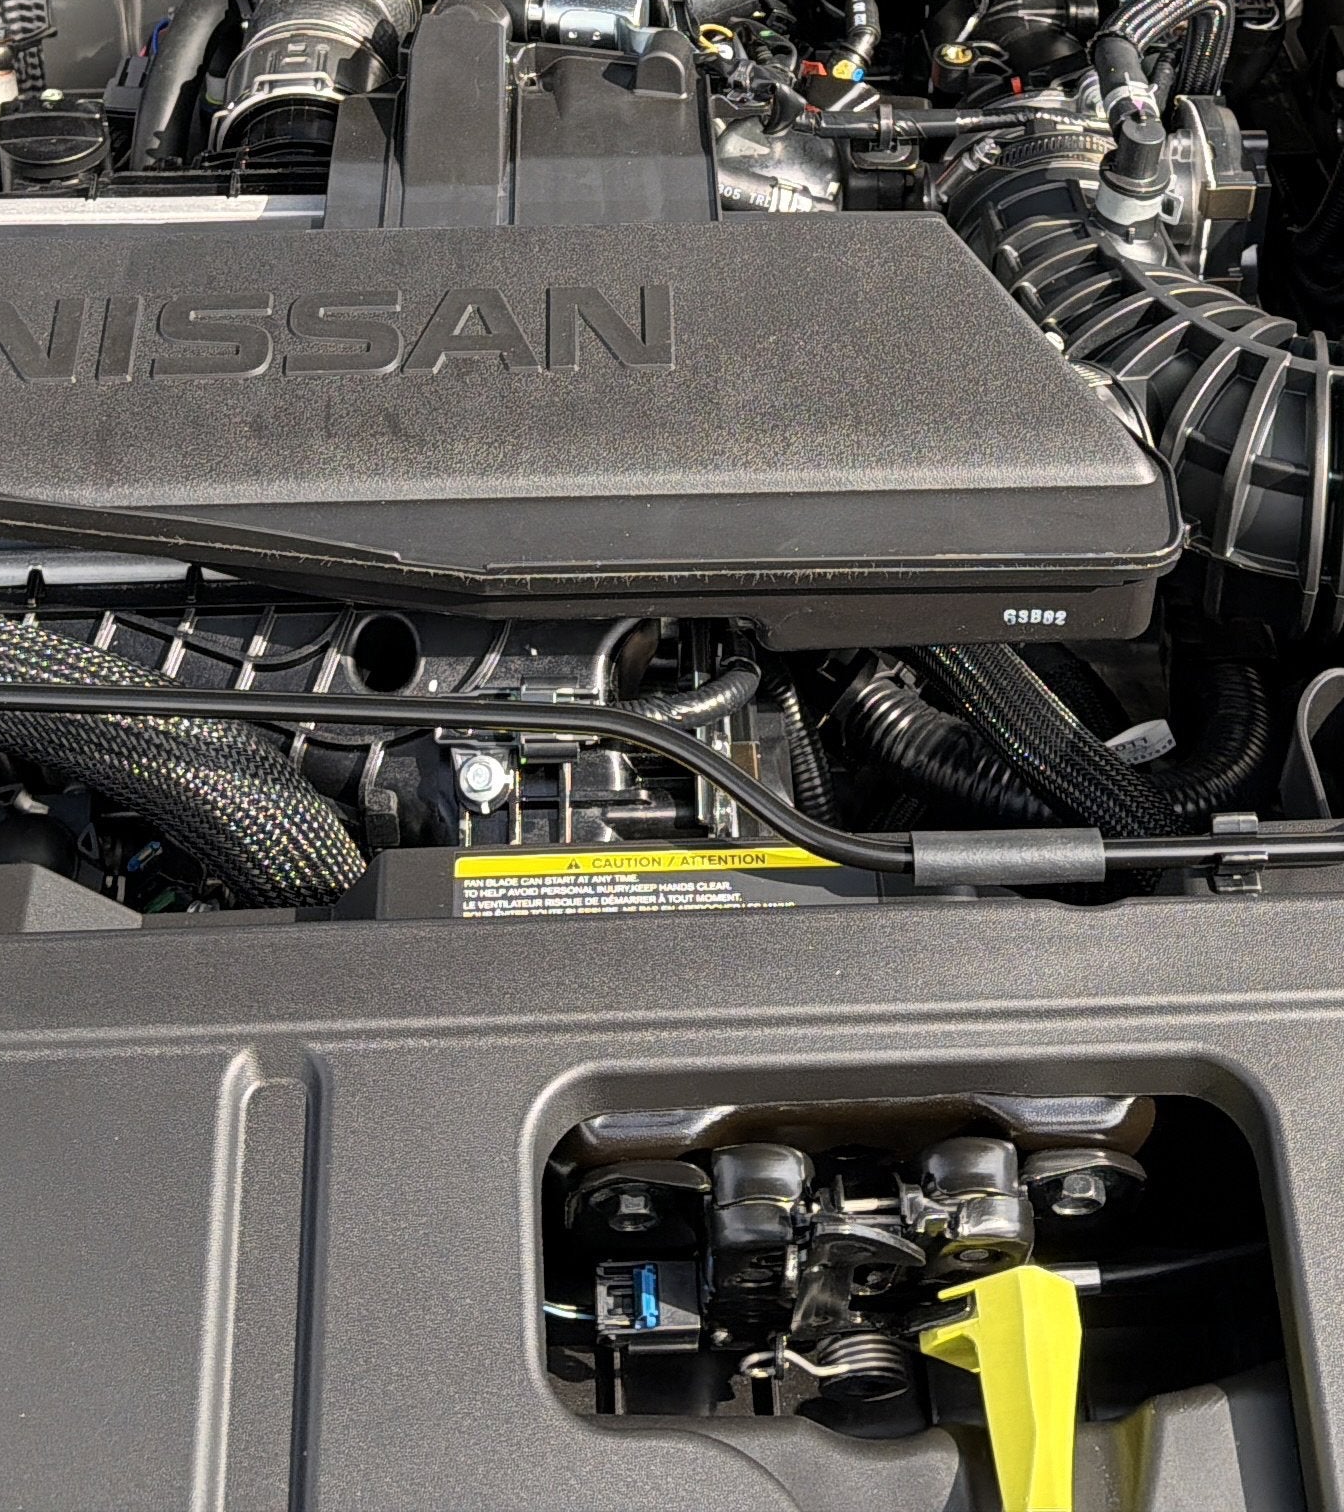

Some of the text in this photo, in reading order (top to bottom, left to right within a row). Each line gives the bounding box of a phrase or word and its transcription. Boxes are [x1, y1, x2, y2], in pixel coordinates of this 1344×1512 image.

[592, 857, 662, 869] CAUTION
[680, 853, 766, 866] ATTENTION
[463, 879, 484, 888] FAN
[485, 878, 519, 887] BLADE
[520, 877, 543, 886] CAN
[544, 876, 576, 885] START
[577, 875, 590, 884] AT
[591, 875, 614, 884] ANY
[463, 890, 479, 899] TO
[480, 889, 506, 898] HELP
[507, 888, 539, 897] AVOID
[541, 886, 595, 896] PERSONAL
[658, 882, 695, 892] HANDS
[463, 901, 476, 910] LE
[478, 899, 543, 910] VENTILATEUR
[545, 897, 583, 907] RISQUE
[585, 896, 599, 906] DE
[601, 893, 656, 906] DÉMARRER
[668, 894, 693, 904] TOUT
[695, 892, 742, 903] MOMENT.
